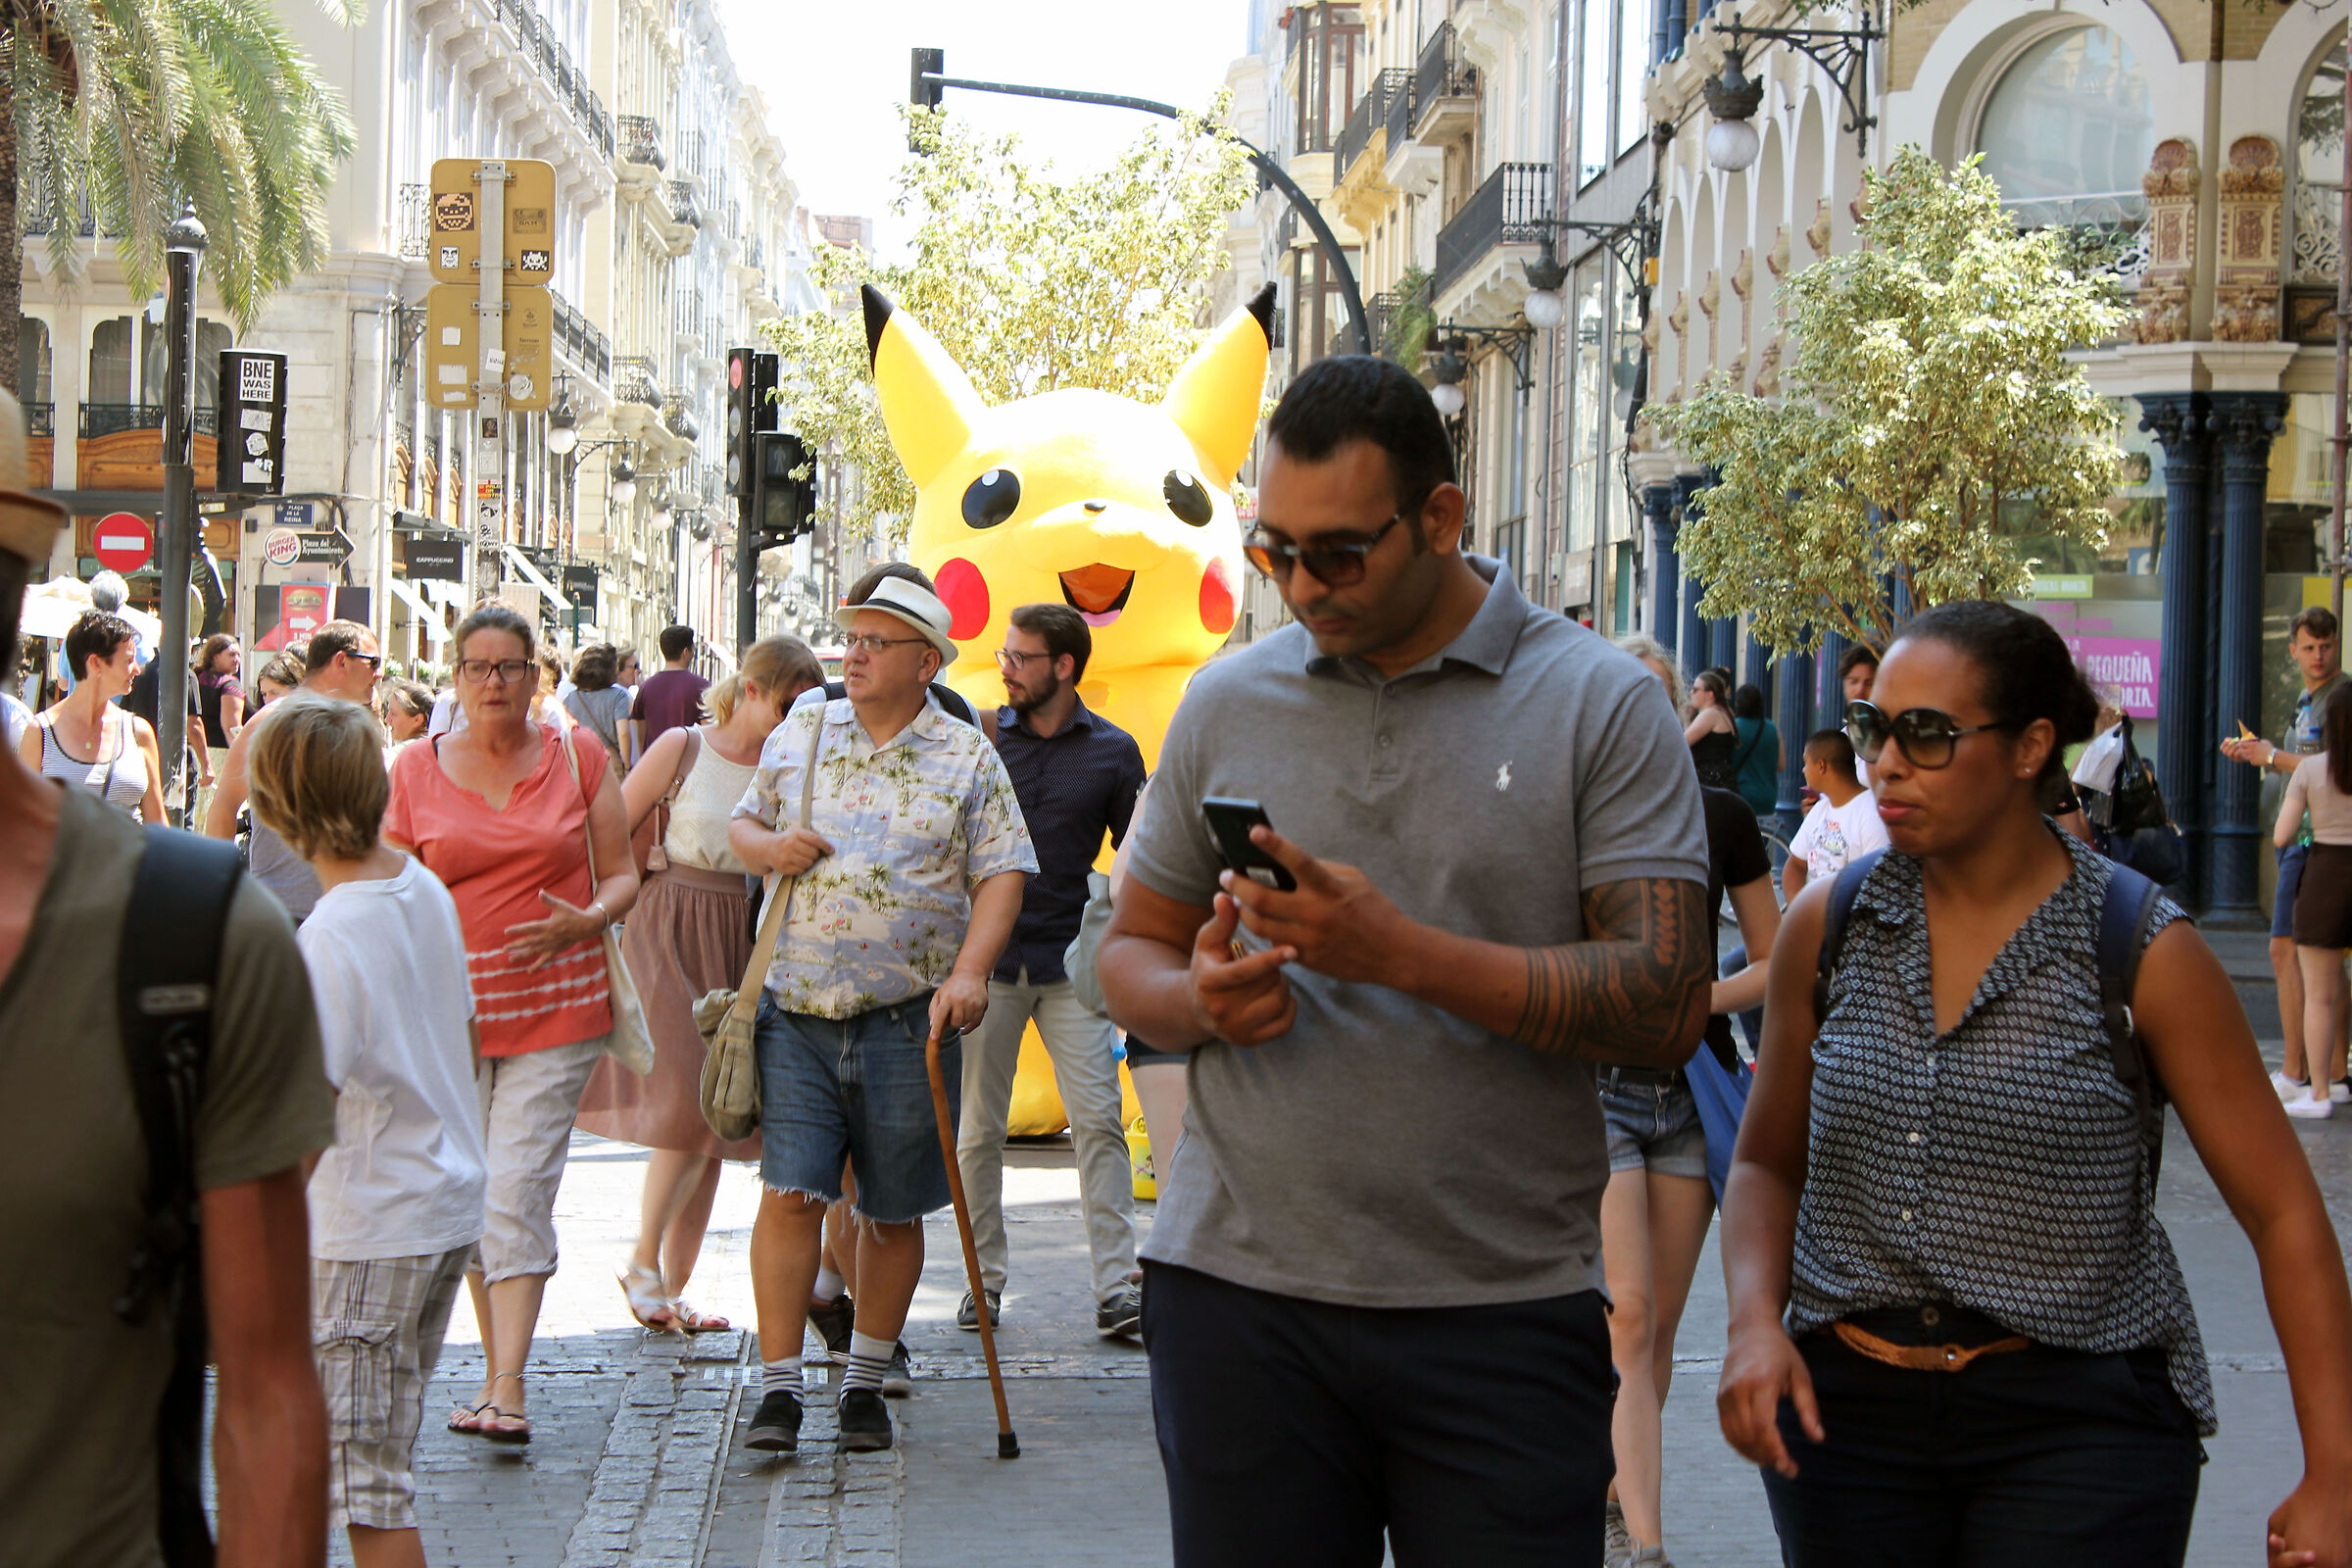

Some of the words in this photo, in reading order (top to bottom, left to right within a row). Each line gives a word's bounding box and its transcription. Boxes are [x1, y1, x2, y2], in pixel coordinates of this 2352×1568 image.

[243, 362, 272, 378] BNE
[243, 379, 271, 389] WAS
[242, 389, 271, 400] HERE
[268, 536, 296, 550] BURGER
[302, 539, 318, 548] Plaza
[319, 537, 329, 548] del
[270, 542, 297, 559] KING
[302, 547, 344, 557] Ayuntamiento
[2086, 651, 2154, 684] PEQUEÑA
